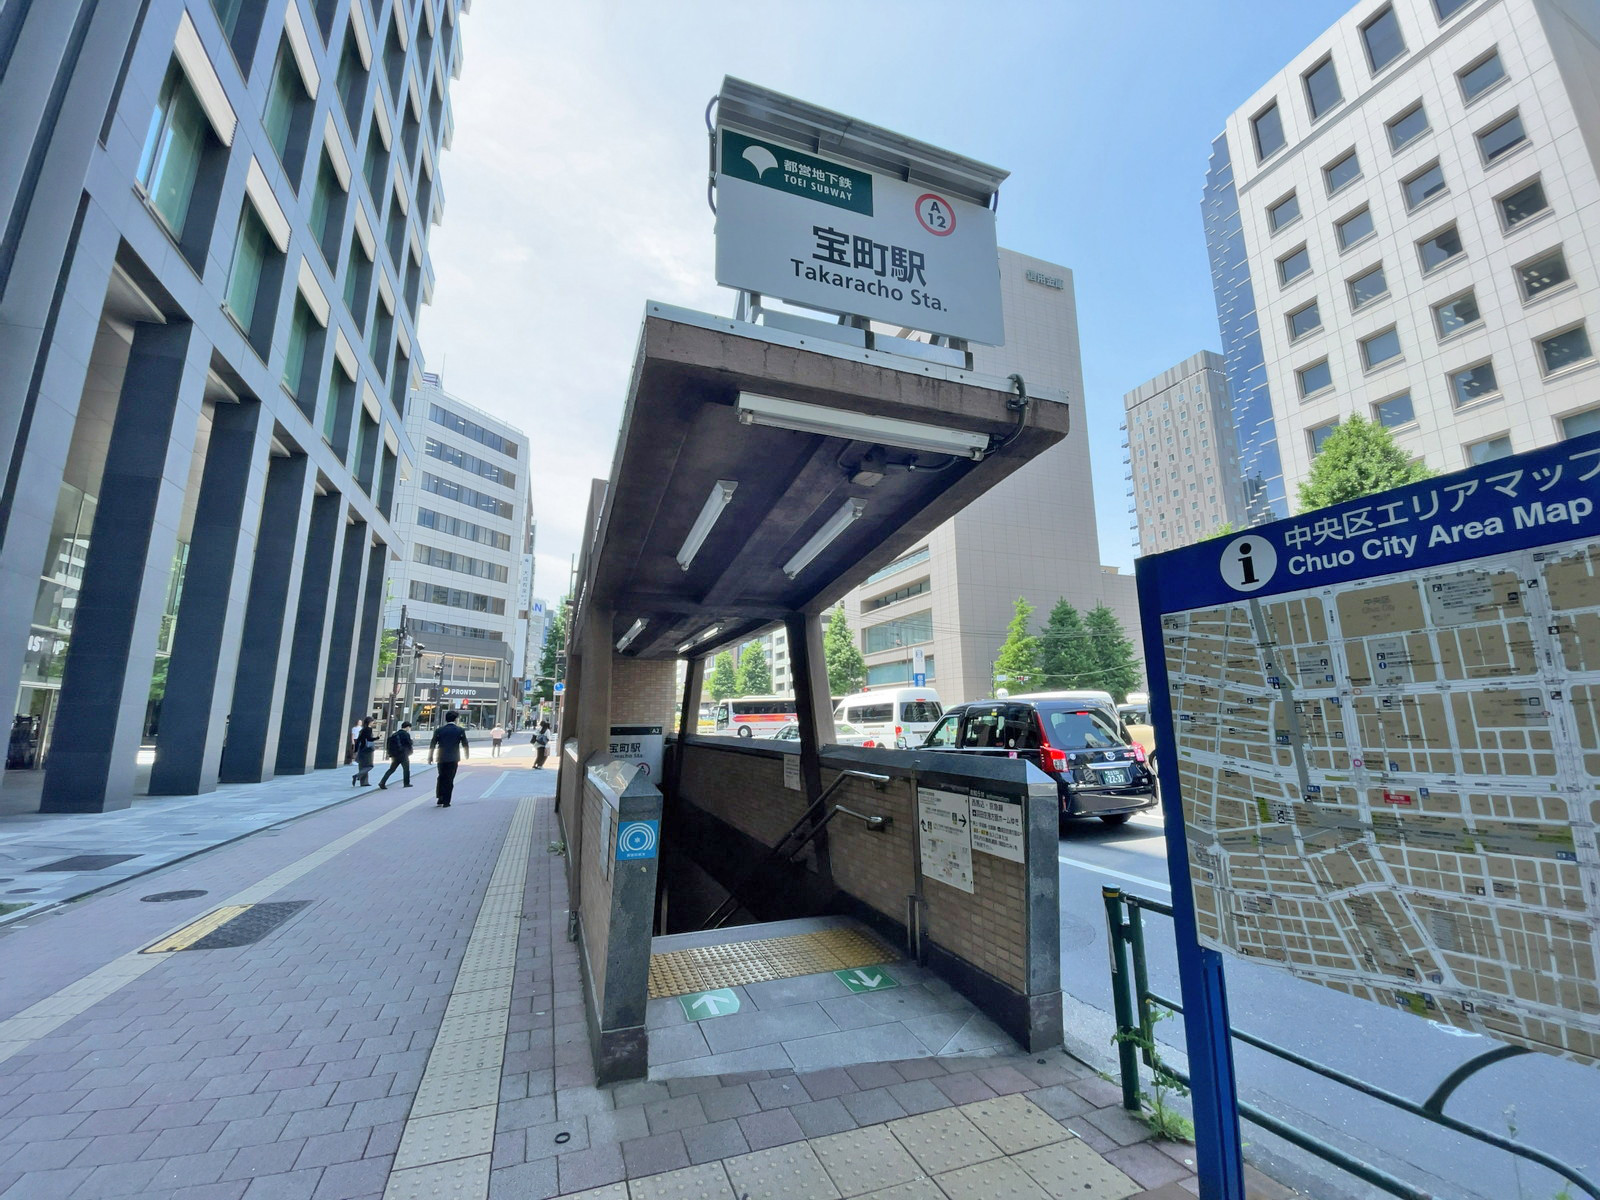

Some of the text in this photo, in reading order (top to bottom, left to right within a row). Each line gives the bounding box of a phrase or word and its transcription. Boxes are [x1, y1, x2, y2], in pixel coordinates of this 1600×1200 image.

[783, 159, 852, 191] 都営地下鉄
[784, 173, 853, 201] TOEI SUBWAY
[928, 212, 946, 229] 12
[930, 201, 941, 214] A
[812, 225, 927, 287] 宝町駅
[790, 258, 948, 313] Takaracho Sta.
[1288, 496, 1594, 576] Chuo City Area Map
[451, 688, 477, 696] PRONTO
[609, 743, 641, 753] 宝町駅
